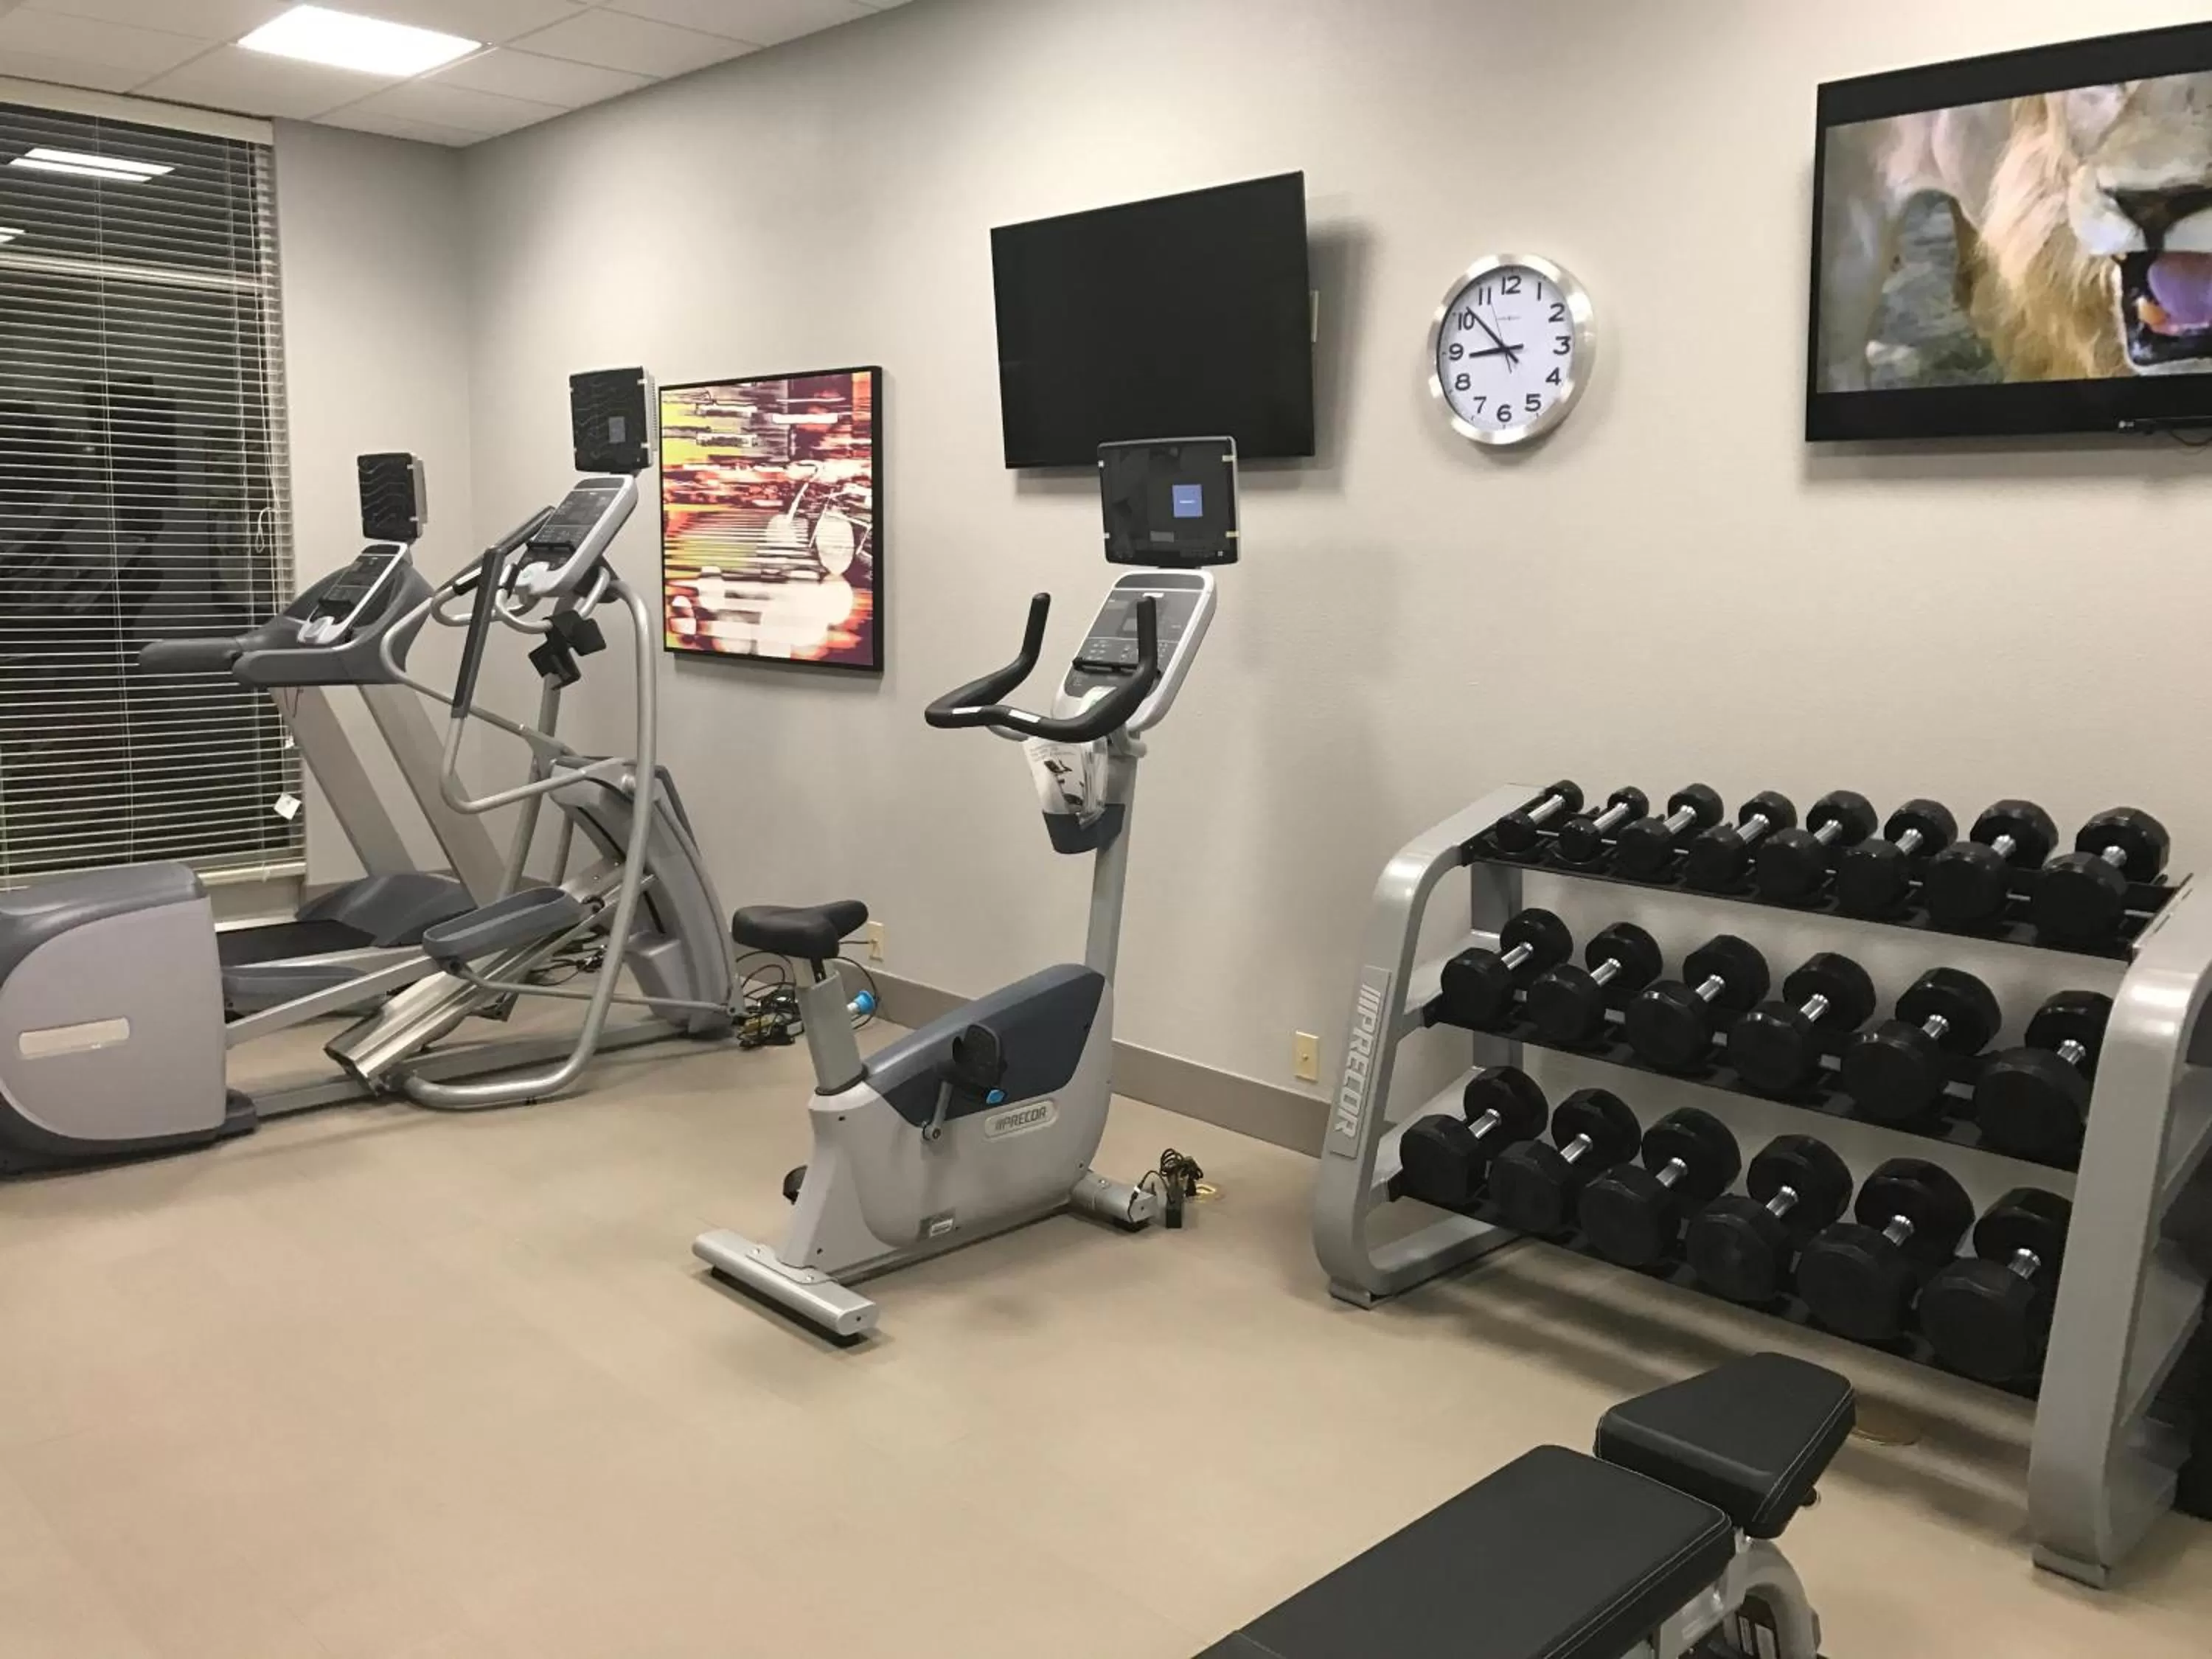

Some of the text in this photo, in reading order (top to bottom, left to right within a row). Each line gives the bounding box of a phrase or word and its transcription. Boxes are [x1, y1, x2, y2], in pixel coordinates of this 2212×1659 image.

[1501, 275, 1521, 295] 12
[1537, 281, 1542, 302] 1
[1478, 286, 1491, 305] 11
[1548, 303, 1565, 323] 2
[1449, 343, 1464, 361] 9
[1554, 336, 1571, 355] 3
[1455, 373, 1470, 391] 8
[1545, 367, 1561, 386] 4
[1473, 396, 1486, 414] 7
[1526, 394, 1541, 411] 5
[1497, 404, 1512, 422] 6
[1334, 1004, 1379, 1138] PRECOR
[1001, 1106, 1047, 1130] PRECOR
